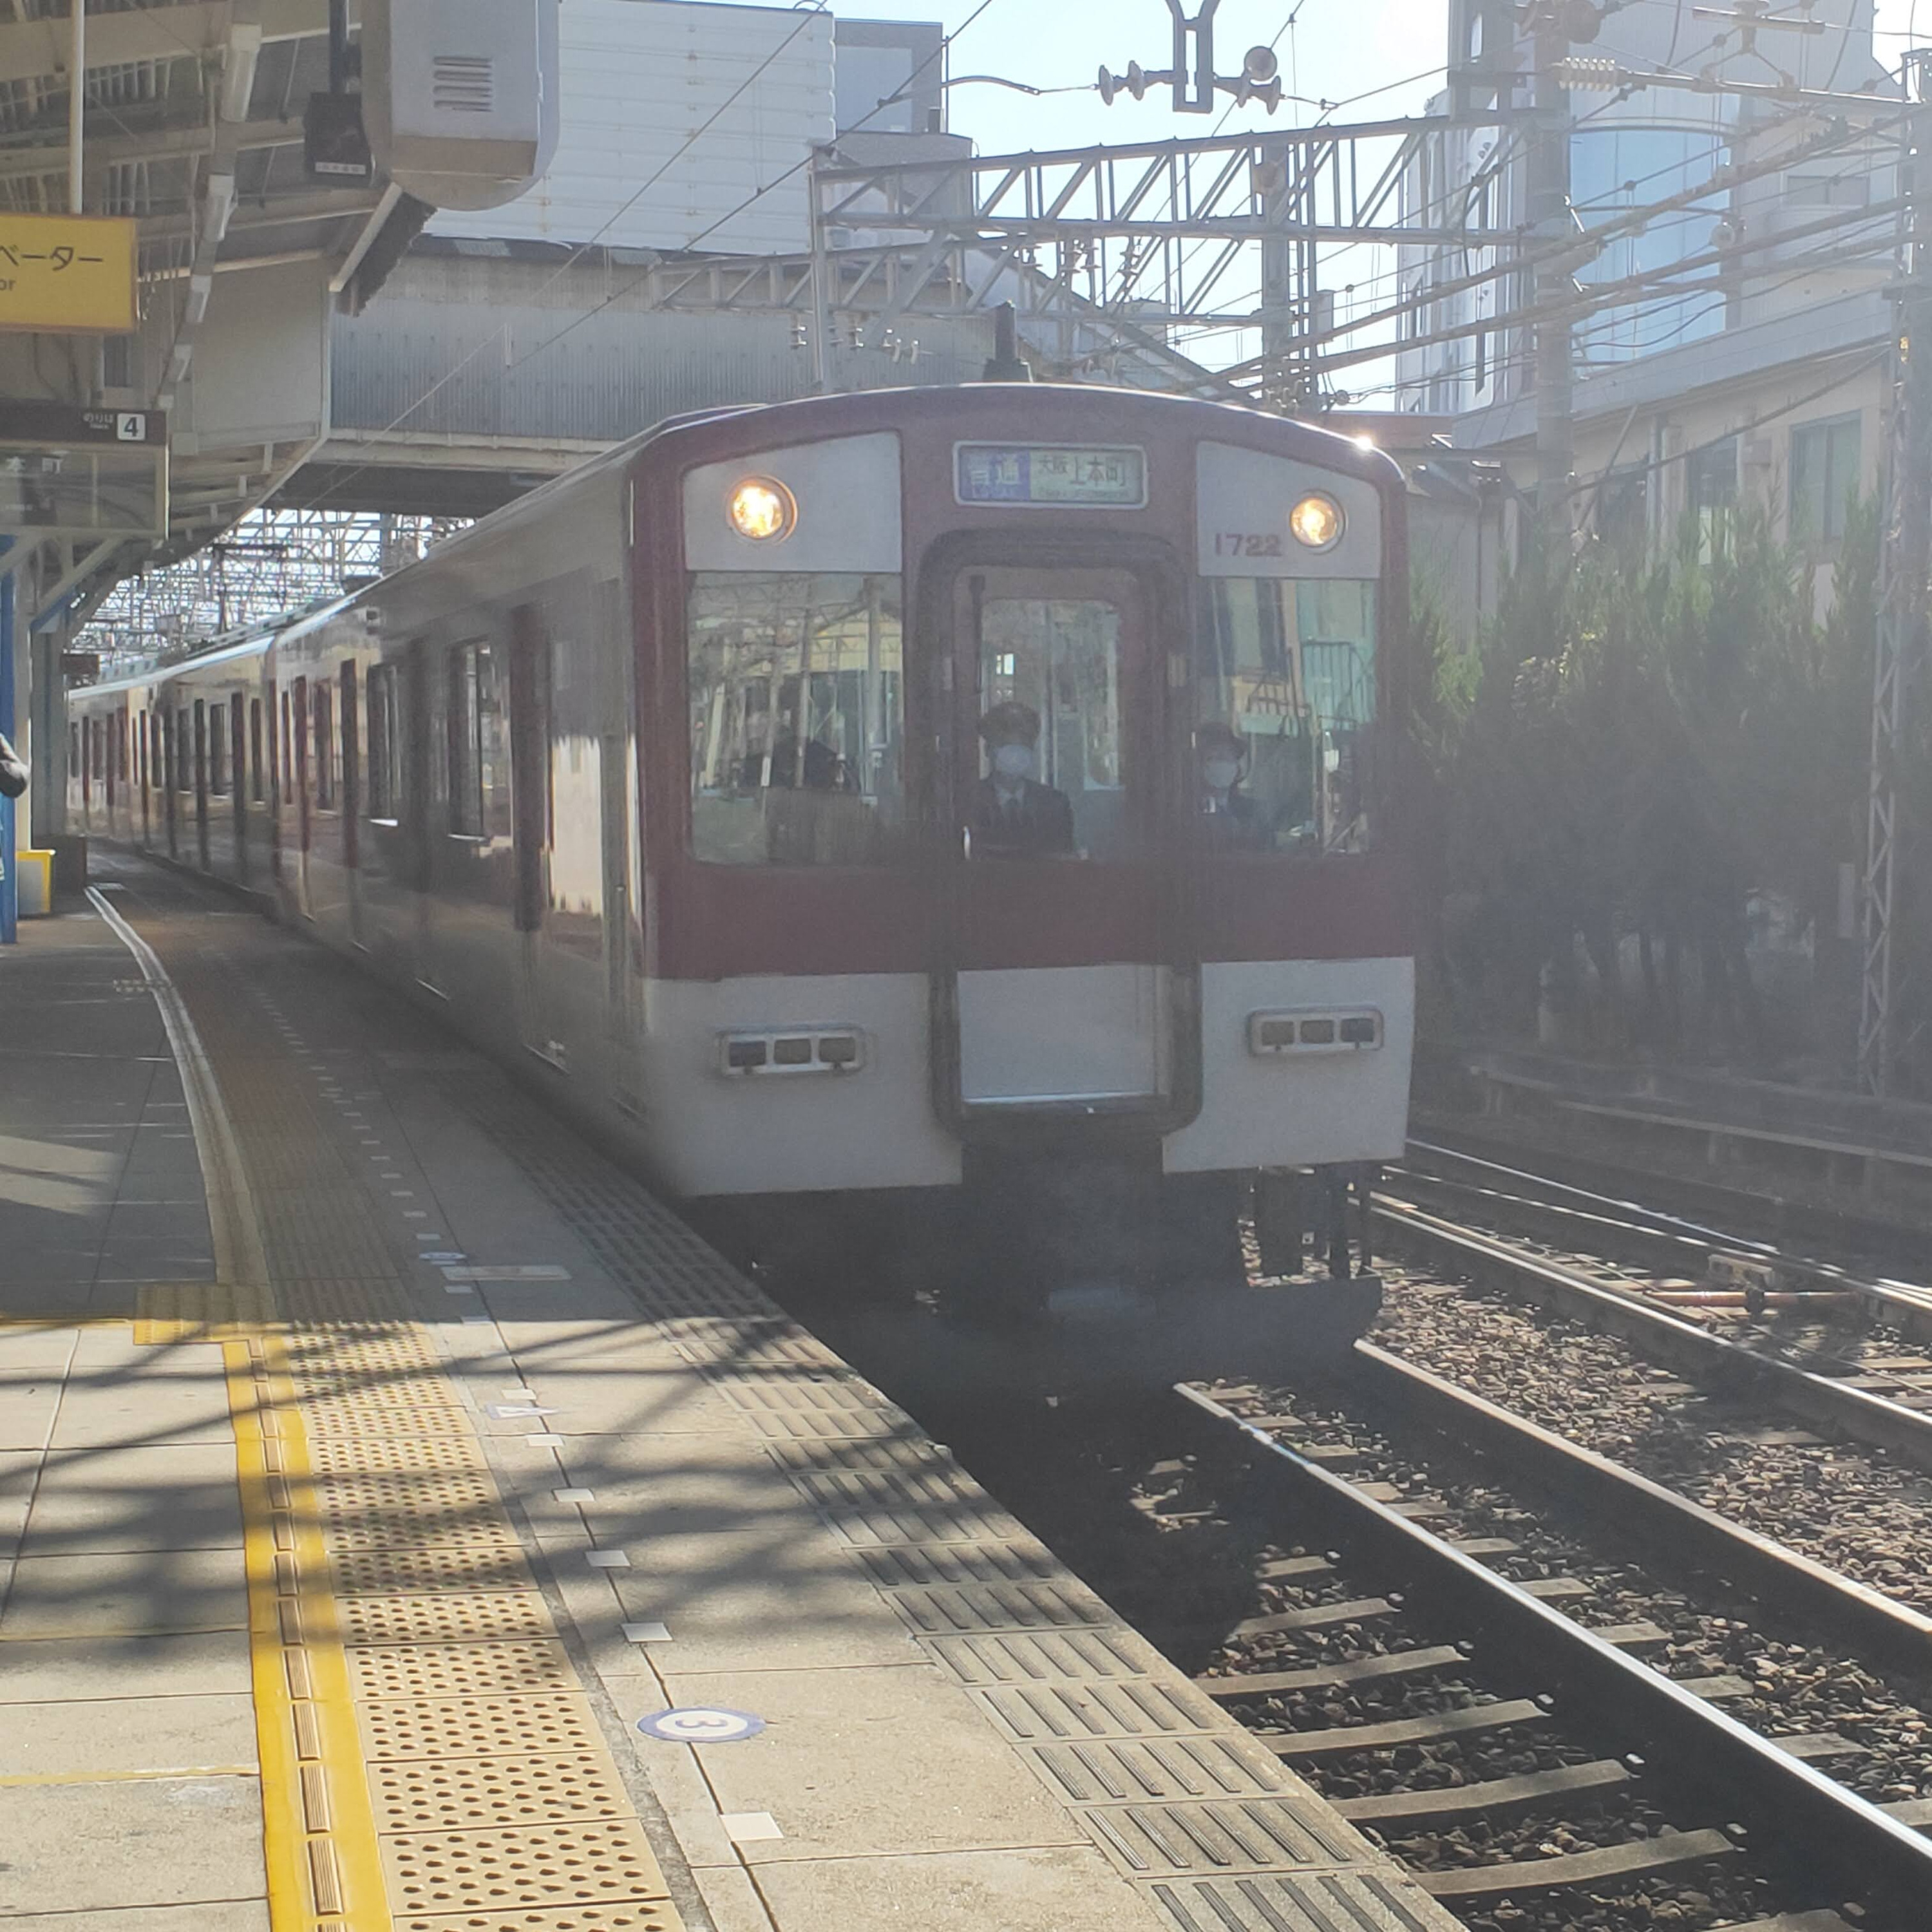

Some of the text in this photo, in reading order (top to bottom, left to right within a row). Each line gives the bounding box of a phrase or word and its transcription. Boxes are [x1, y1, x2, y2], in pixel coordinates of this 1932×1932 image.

[83, 413, 113, 423] のりば
[124, 417, 139, 437] 4
[1215, 533, 1283, 556] 1722
